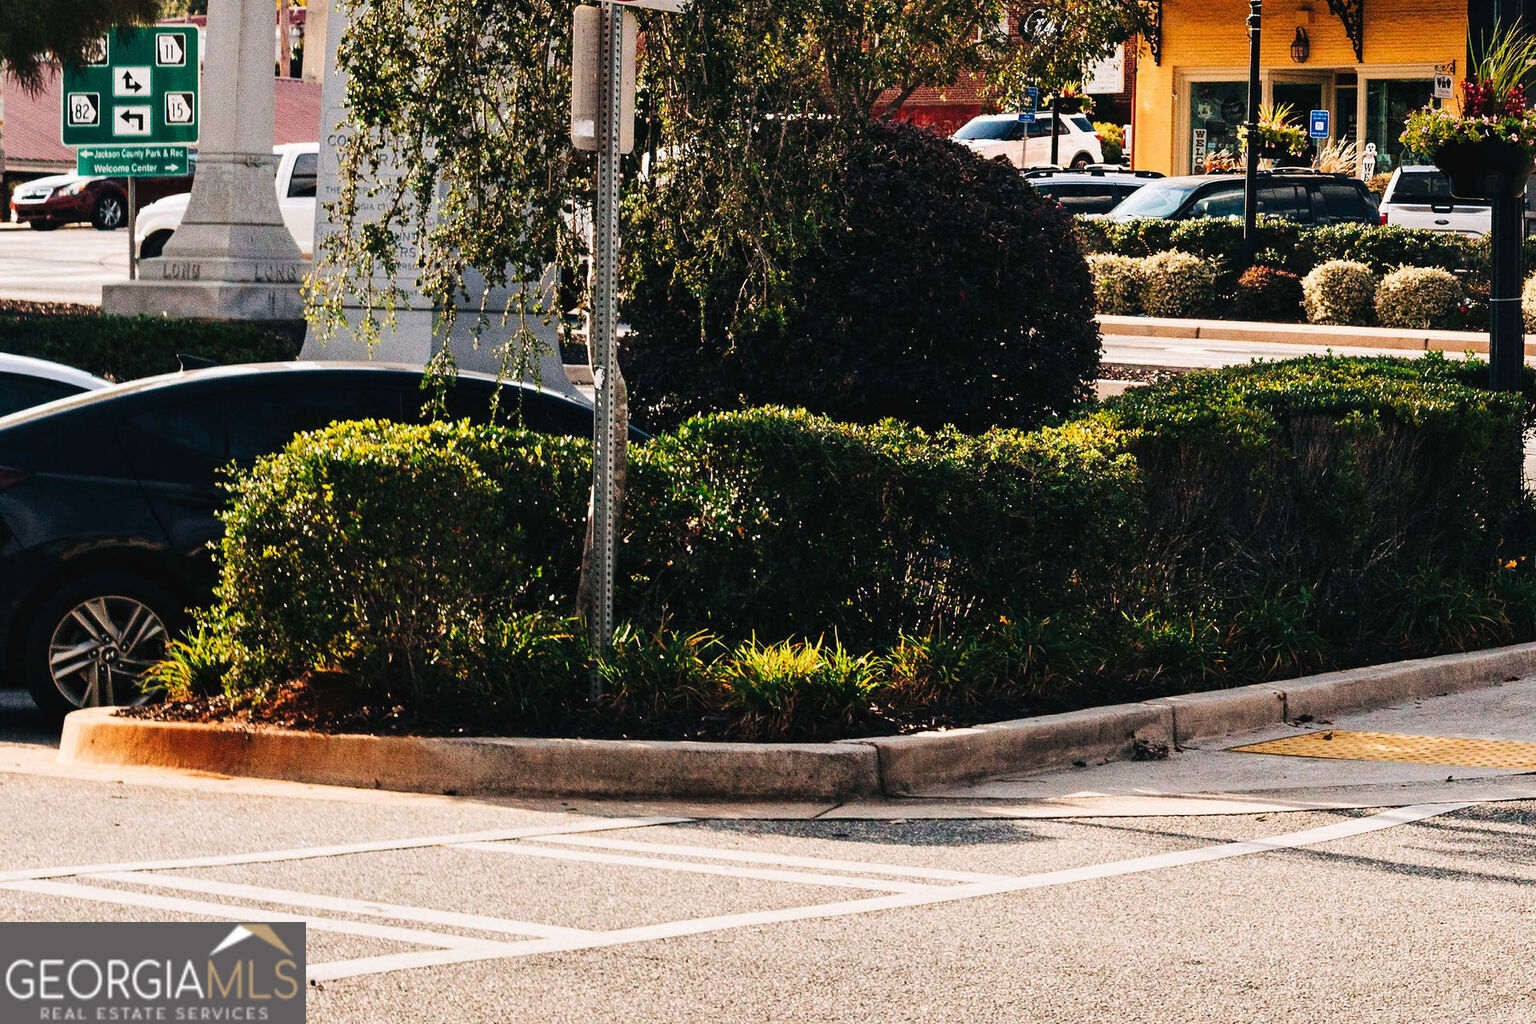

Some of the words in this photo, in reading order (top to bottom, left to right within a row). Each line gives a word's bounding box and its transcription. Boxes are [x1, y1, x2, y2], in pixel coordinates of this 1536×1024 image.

[75, 103, 90, 120] 82
[172, 102, 184, 118] 15
[95, 148, 120, 159] Jackson
[121, 148, 144, 160] County
[145, 148, 161, 158] Park
[163, 148, 169, 158] &
[170, 148, 184, 158] Rec
[1194, 130, 1206, 175] WELCO
[93, 163, 130, 173] Welcome
[131, 163, 157, 173] Center
